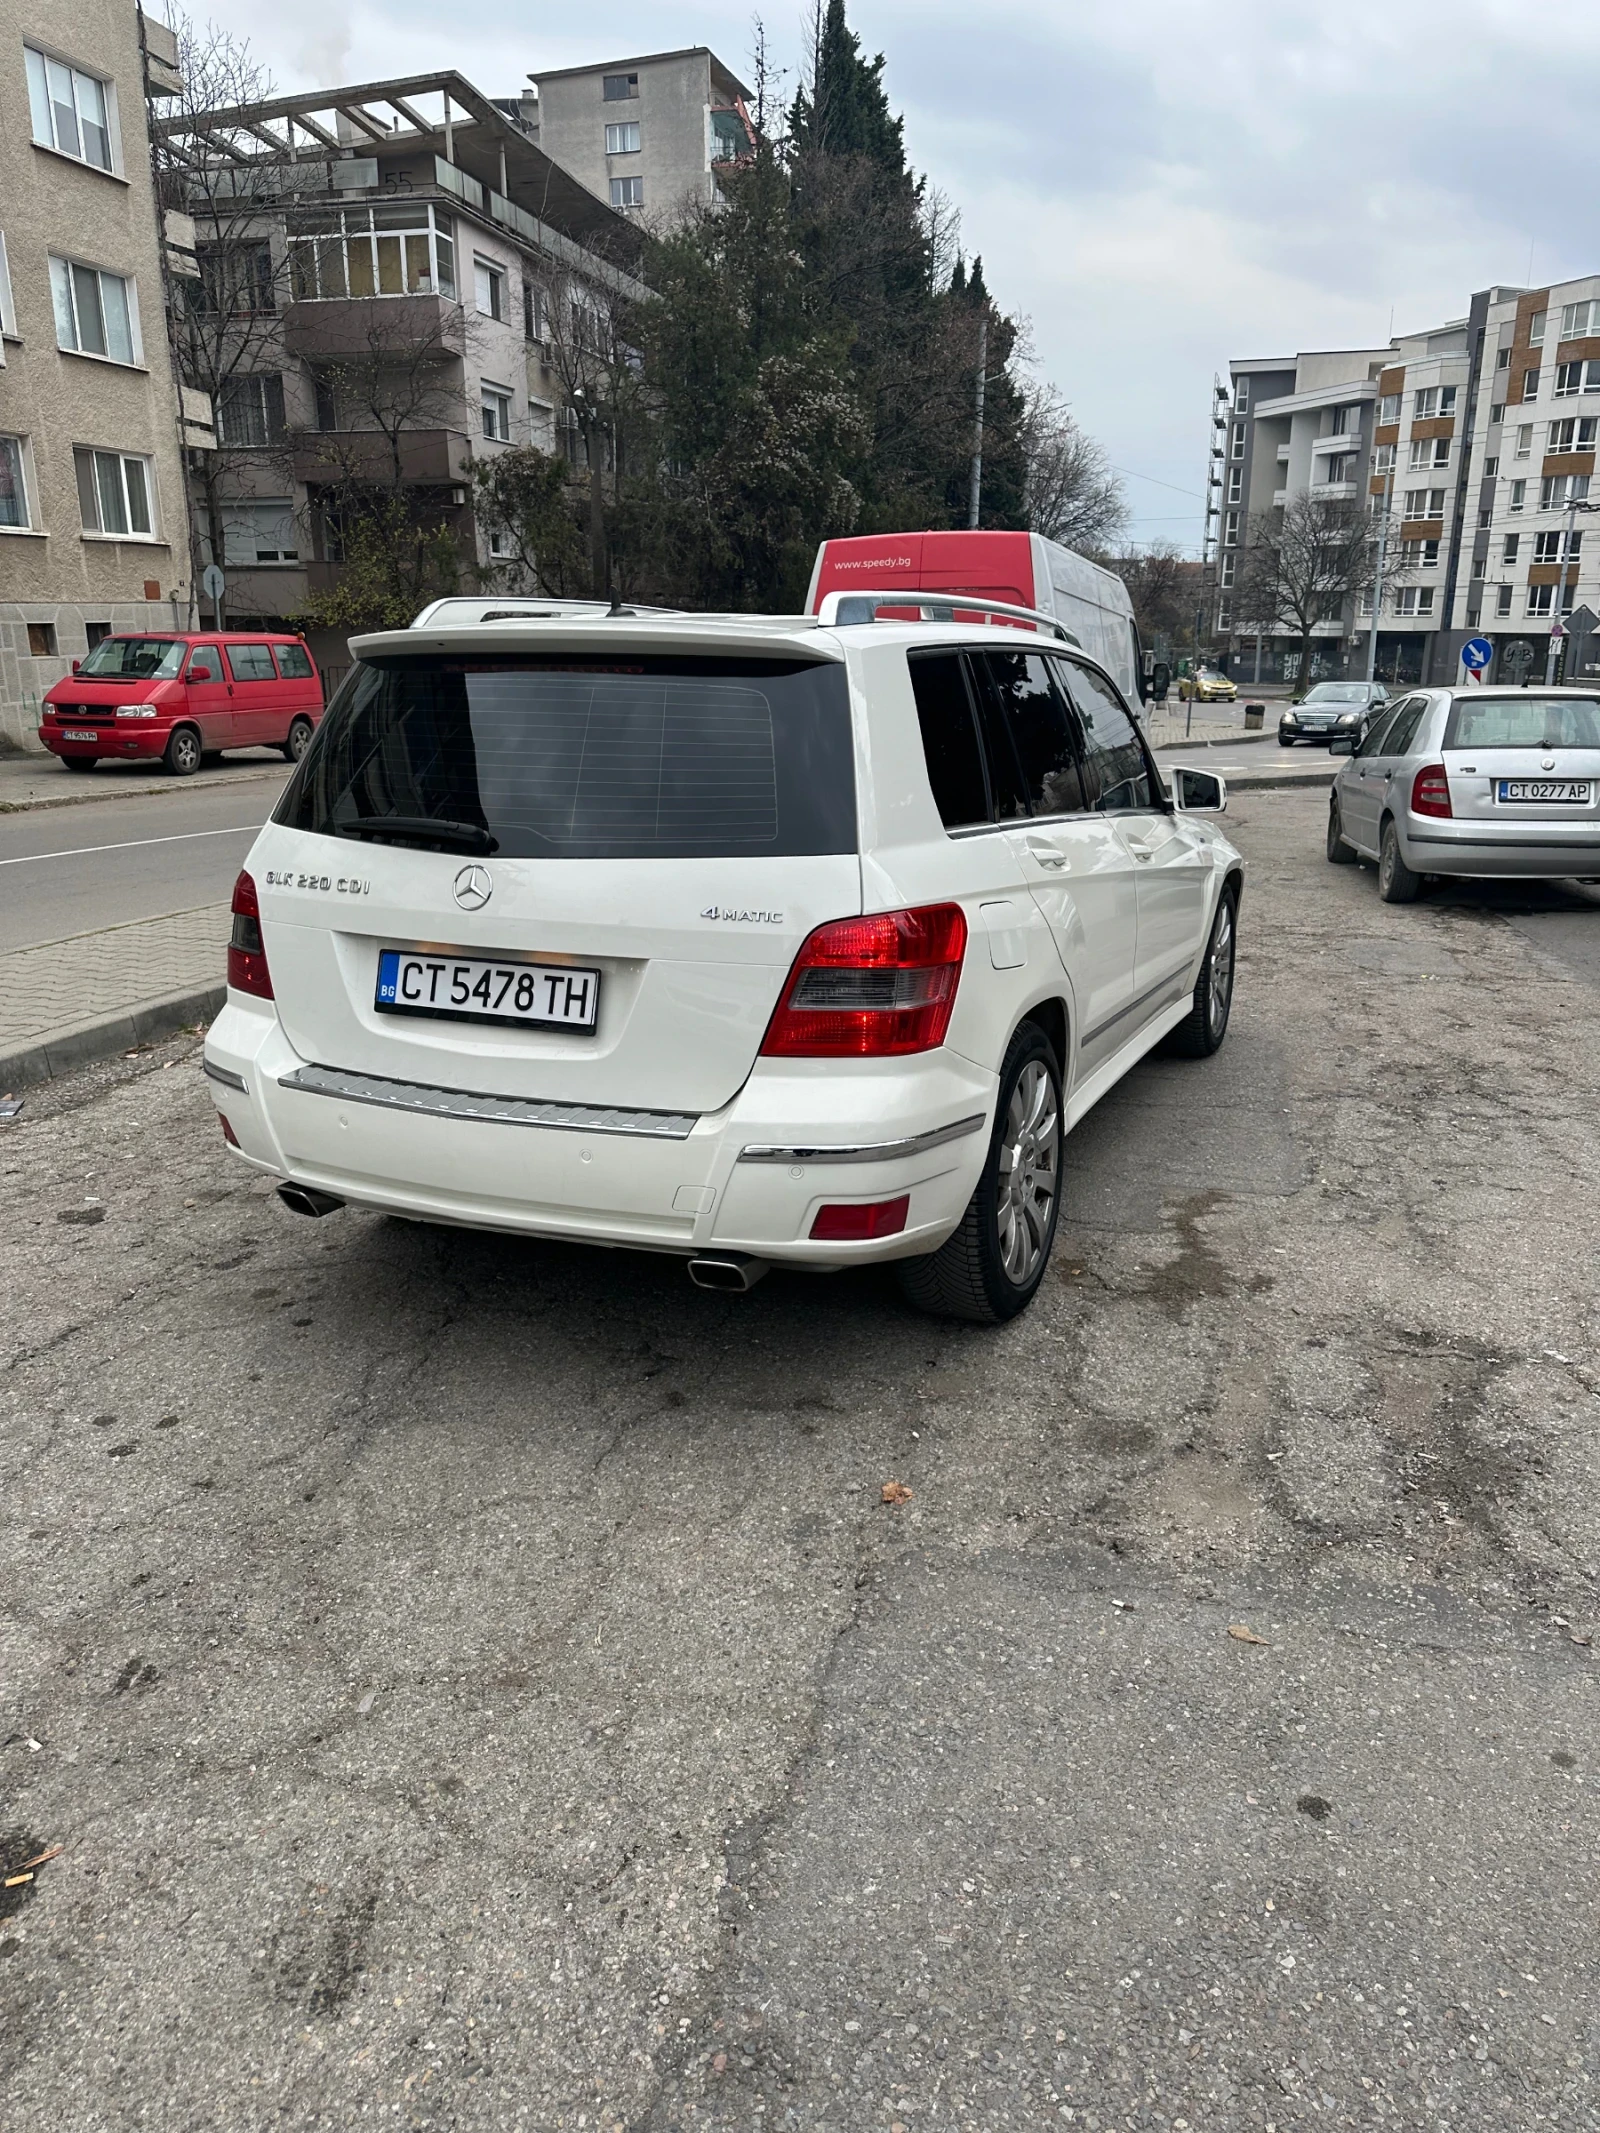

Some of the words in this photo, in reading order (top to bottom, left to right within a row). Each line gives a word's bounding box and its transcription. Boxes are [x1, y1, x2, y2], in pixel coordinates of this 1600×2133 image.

[384, 171, 413, 195] 55
[834, 556, 911, 570] www.speedy.bg
[1509, 784, 1528, 797] CT
[1531, 784, 1566, 798] 0277
[1568, 785, 1587, 798] AP
[266, 871, 294, 887] GLK
[297, 874, 331, 890] 220
[337, 878, 370, 895] CDI
[381, 985, 395, 997] BG
[401, 962, 446, 1002] CT
[451, 967, 534, 1012] 5478
[543, 975, 589, 1018] TH
